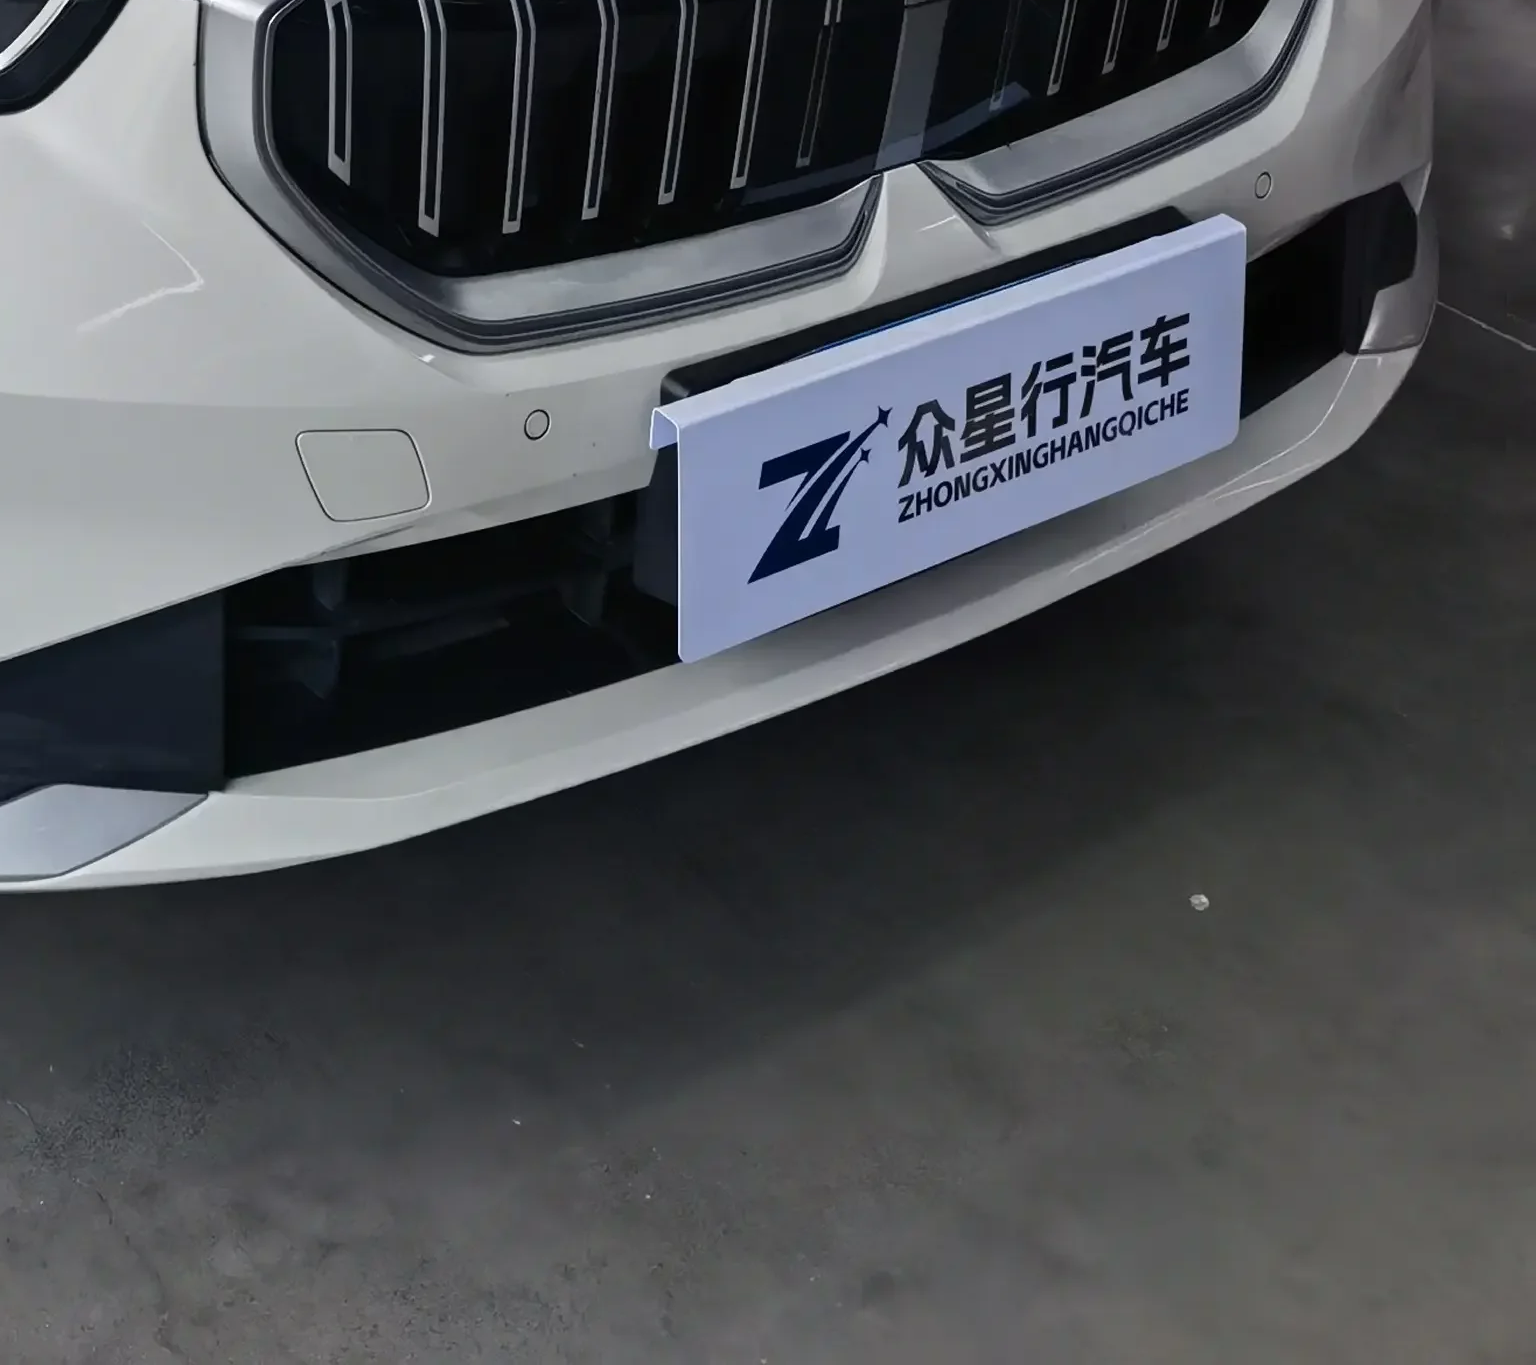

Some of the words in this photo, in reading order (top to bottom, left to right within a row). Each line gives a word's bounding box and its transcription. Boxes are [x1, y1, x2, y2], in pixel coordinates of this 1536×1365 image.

[897, 312, 1191, 489] 众星行汽车
[898, 388, 1191, 524] ZHONGXINGHANGQICHE
